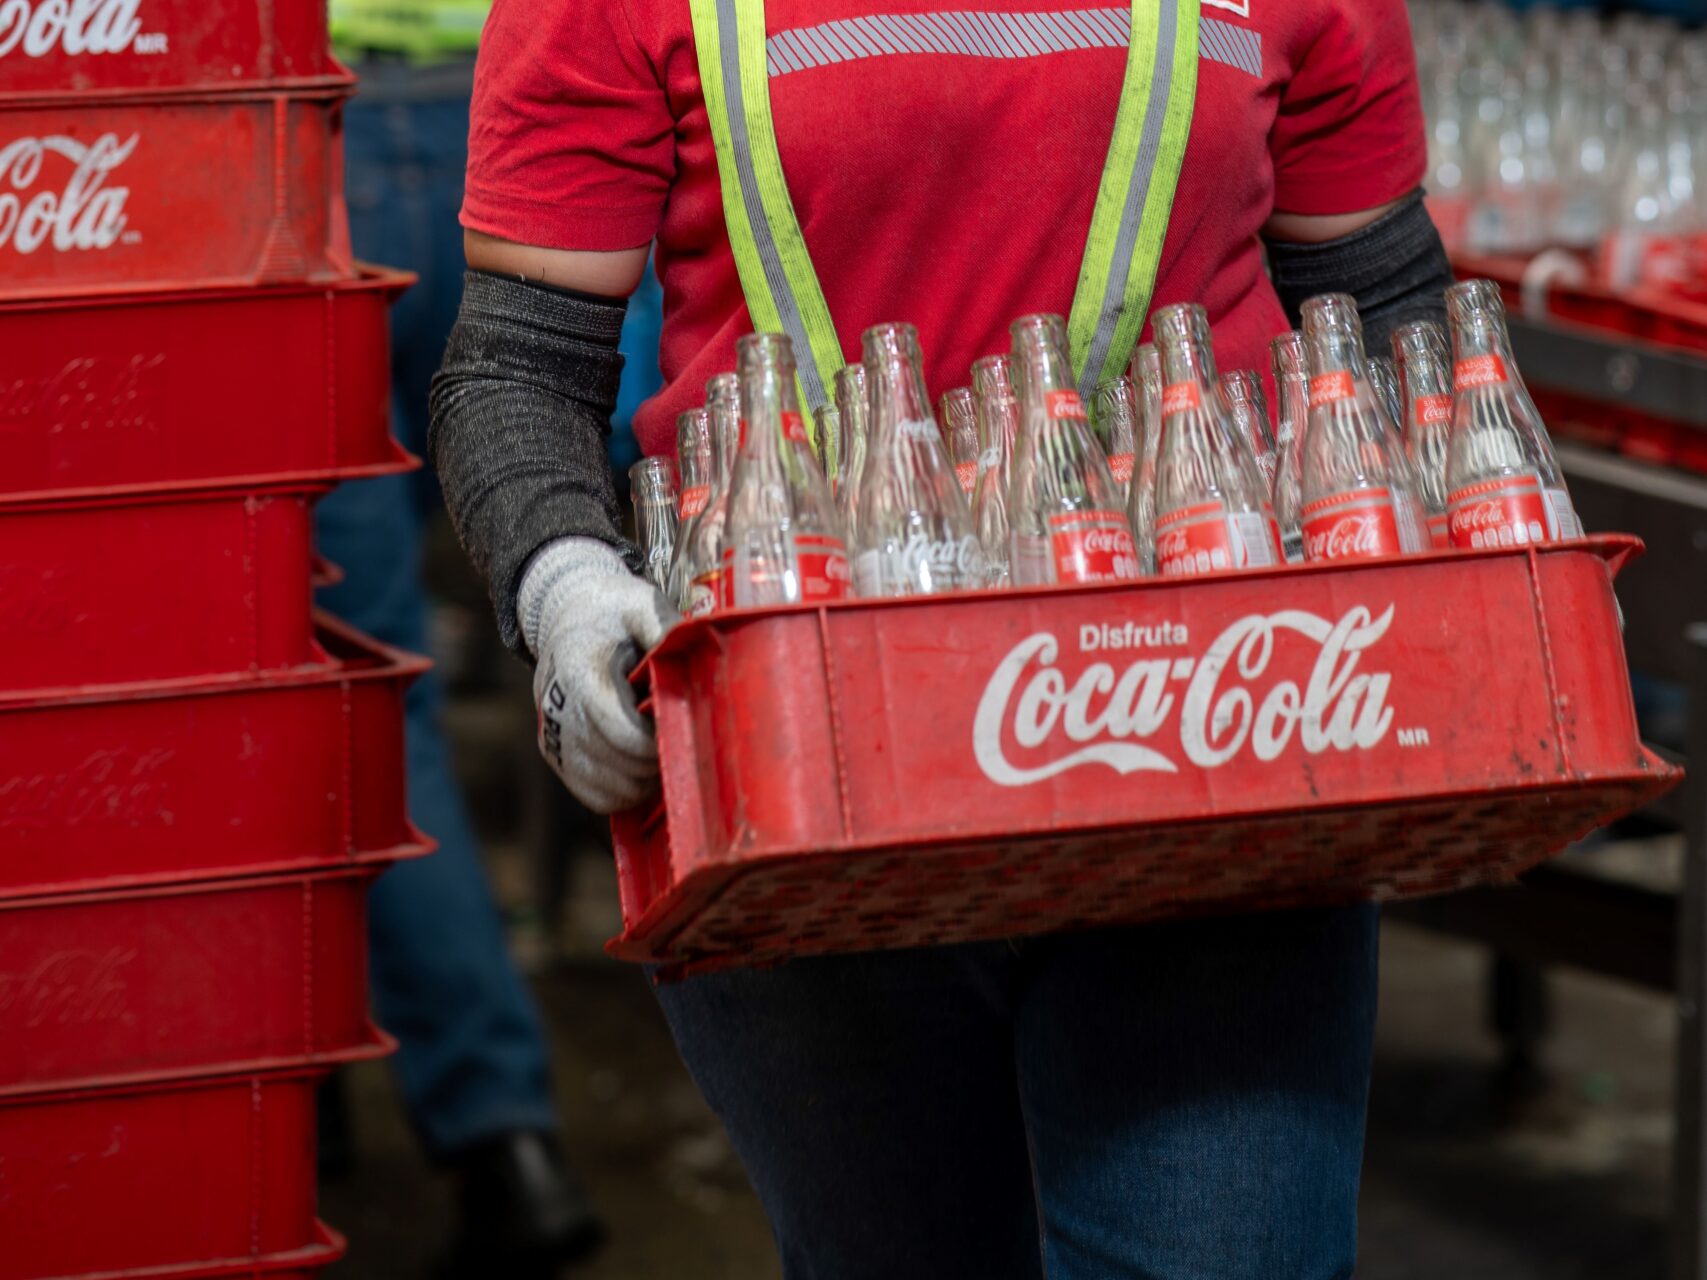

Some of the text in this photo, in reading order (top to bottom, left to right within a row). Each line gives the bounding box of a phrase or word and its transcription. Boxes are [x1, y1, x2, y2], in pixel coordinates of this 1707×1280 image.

[1079, 622, 1189, 653] Disfruta
[973, 602, 1429, 787] Coca-Cola MR
